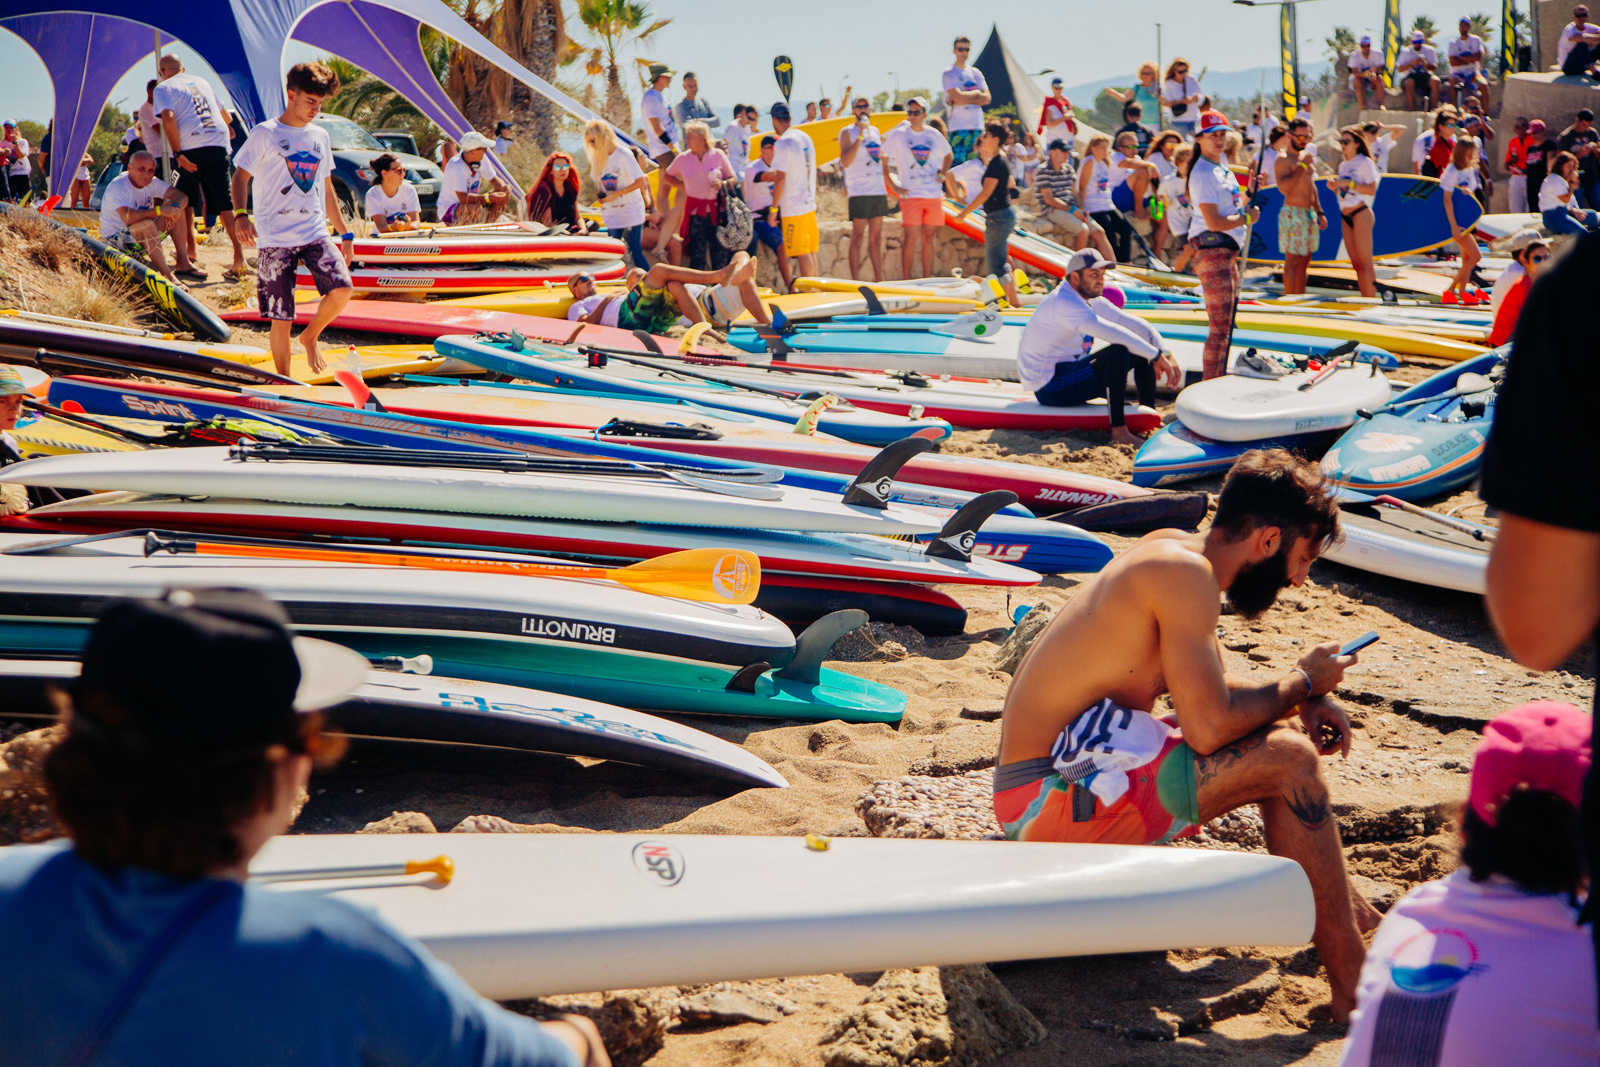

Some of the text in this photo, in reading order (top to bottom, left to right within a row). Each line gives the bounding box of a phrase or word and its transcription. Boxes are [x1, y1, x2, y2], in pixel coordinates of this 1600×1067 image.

[121, 394, 198, 421] Sprint
[1034, 488, 1104, 505] FANATIC
[521, 617, 616, 644] BRUNOTTI
[641, 845, 676, 880] NSP
